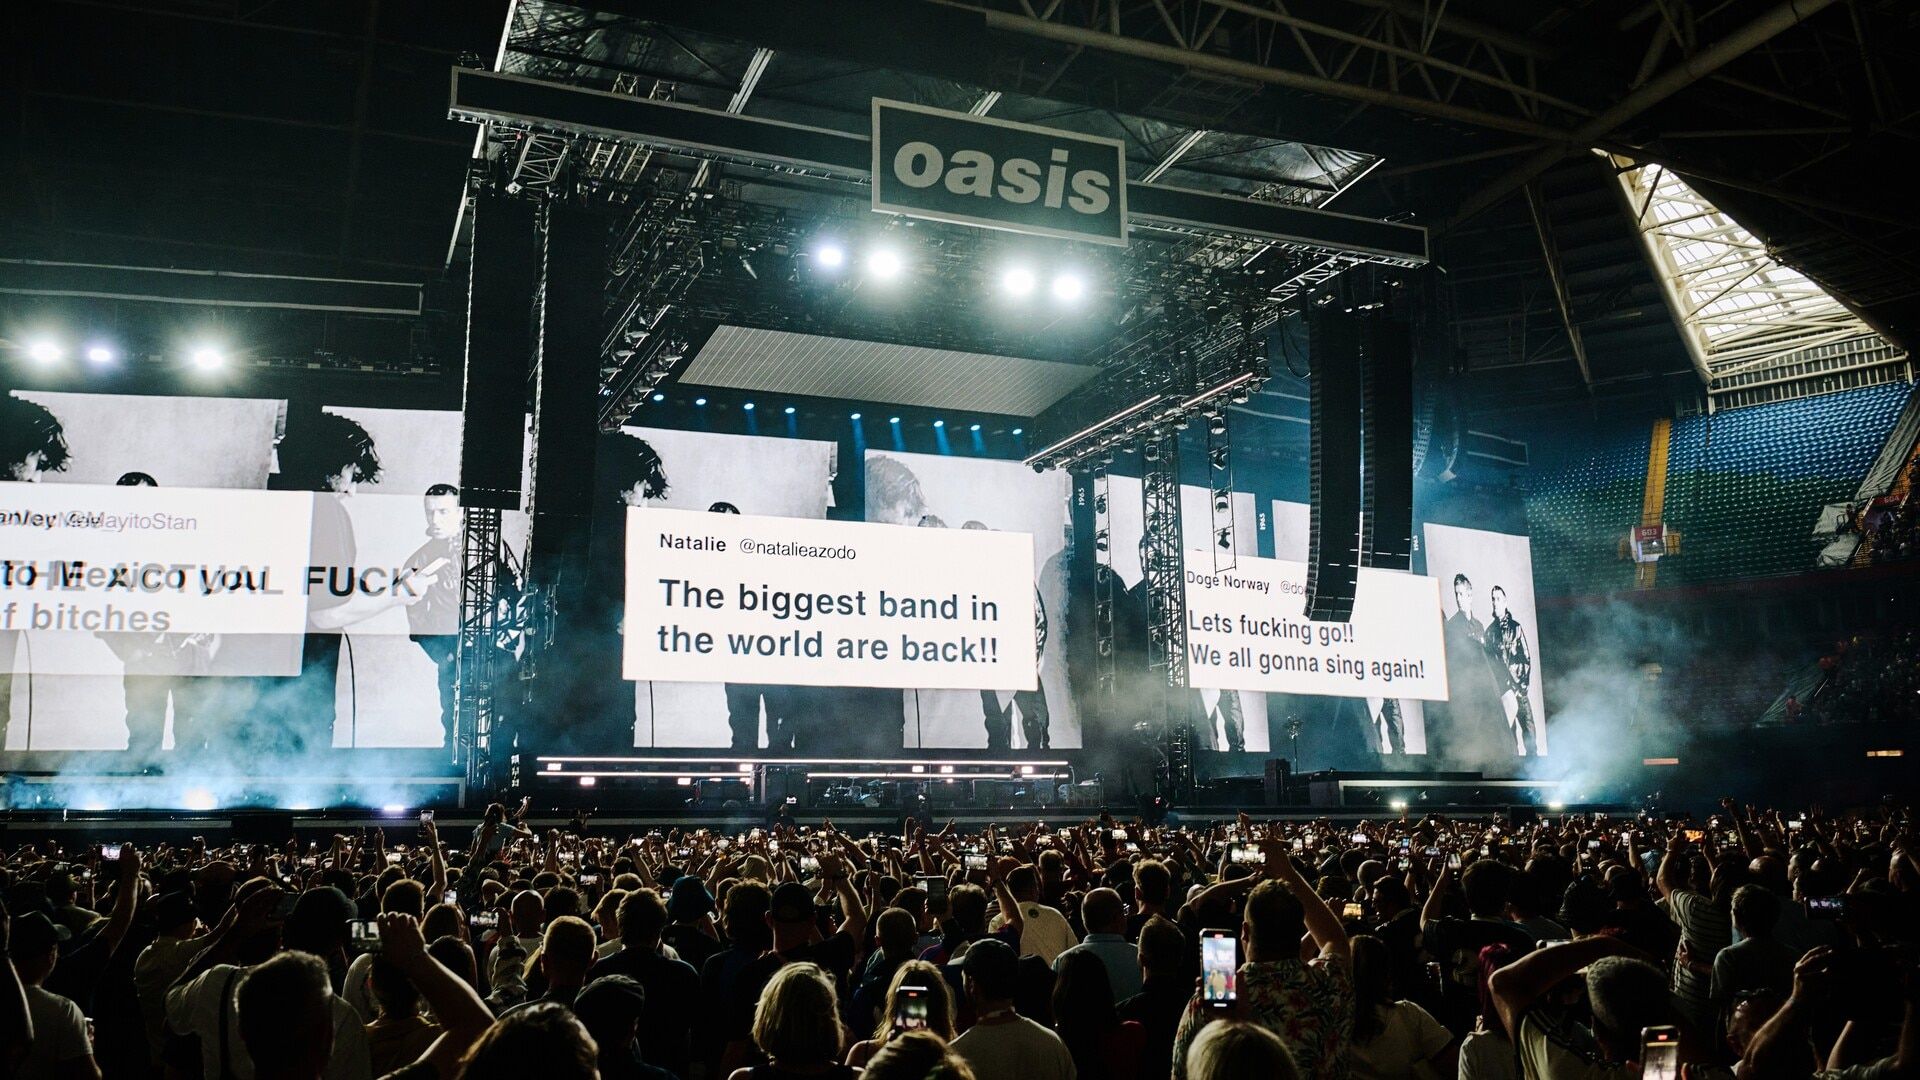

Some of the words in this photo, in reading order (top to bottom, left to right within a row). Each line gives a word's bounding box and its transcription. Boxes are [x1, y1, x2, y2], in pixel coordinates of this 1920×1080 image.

[893, 141, 1111, 215] oasis
[1078, 487, 1086, 506] 1965
[659, 532, 727, 553] Natalie
[739, 538, 857, 560] @natalieazodo
[303, 565, 418, 598] FUCK
[1187, 570, 1220, 589] Doge
[1223, 574, 1270, 595] Norway
[31, 602, 171, 632] bitches
[659, 579, 725, 610] The
[739, 582, 867, 621] biggest
[879, 590, 958, 620] band
[971, 594, 998, 622] in
[657, 624, 714, 654] the
[727, 629, 823, 658] world
[836, 638, 889, 661] are
[901, 633, 998, 664] back!!
[1189, 609, 1233, 634] Lets
[1239, 614, 1312, 646] fucking
[1318, 623, 1354, 647] go!!
[1190, 642, 1222, 666] We
[1228, 646, 1252, 668] all
[1259, 653, 1319, 675] gonna
[1326, 653, 1365, 681] sing
[1371, 658, 1425, 683] again!
